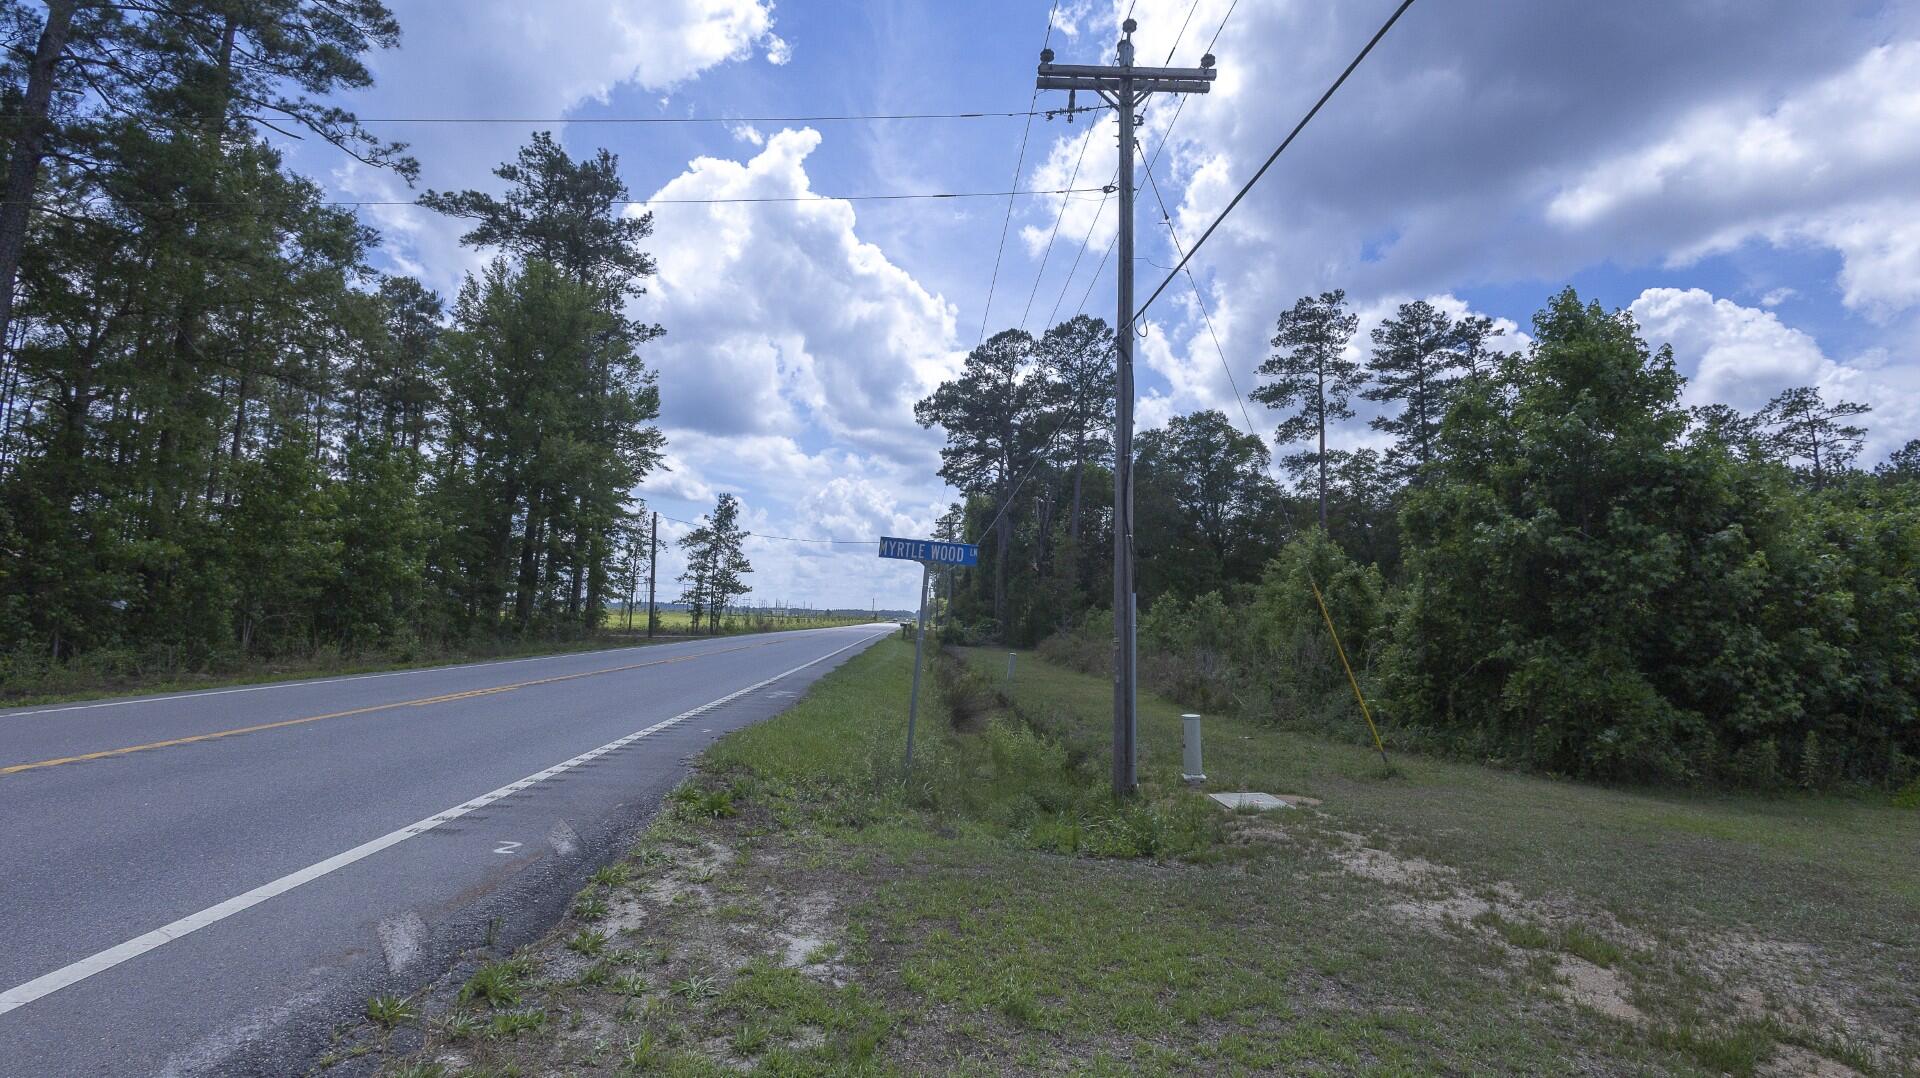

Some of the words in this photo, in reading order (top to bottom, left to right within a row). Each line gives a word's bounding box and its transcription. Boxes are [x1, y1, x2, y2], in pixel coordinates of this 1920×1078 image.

[880, 540, 925, 559] MYRTLE
[931, 544, 964, 562] WOOD
[969, 547, 978, 557] LN
